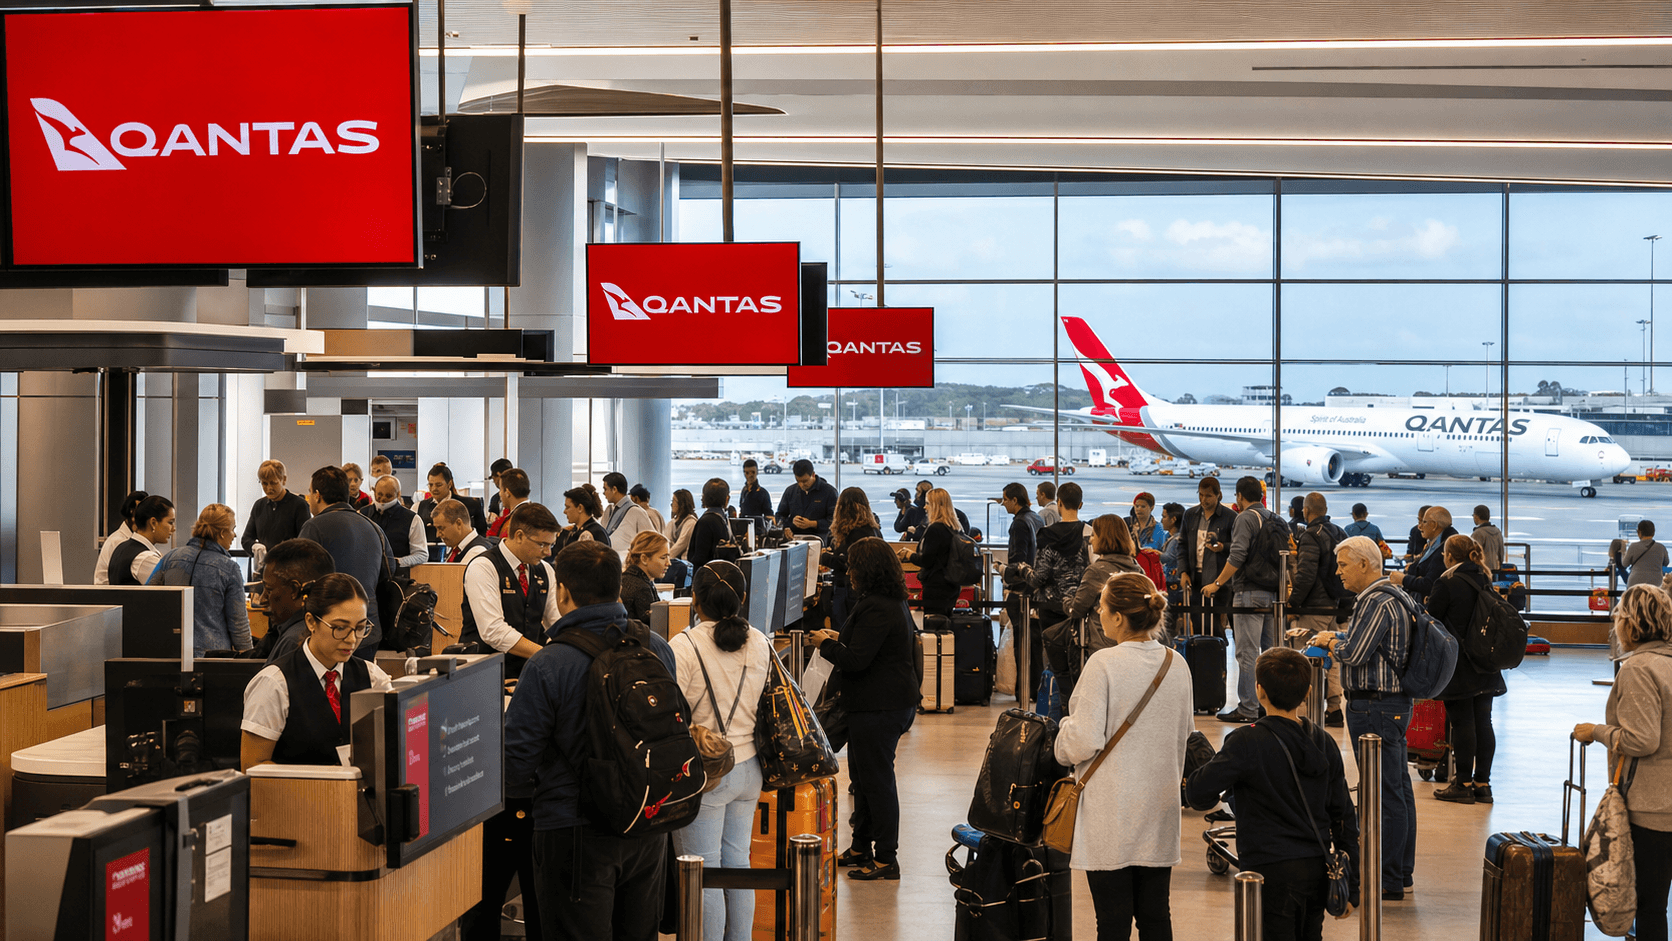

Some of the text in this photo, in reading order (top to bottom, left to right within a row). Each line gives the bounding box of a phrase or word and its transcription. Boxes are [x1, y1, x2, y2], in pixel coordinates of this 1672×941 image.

[110, 120, 380, 157] QANTAS
[642, 295, 782, 314] QANTAS
[827, 341, 922, 354] QANTAS
[1310, 414, 1366, 424] Spirit of Australia
[1405, 415, 1531, 435] QANTAS
